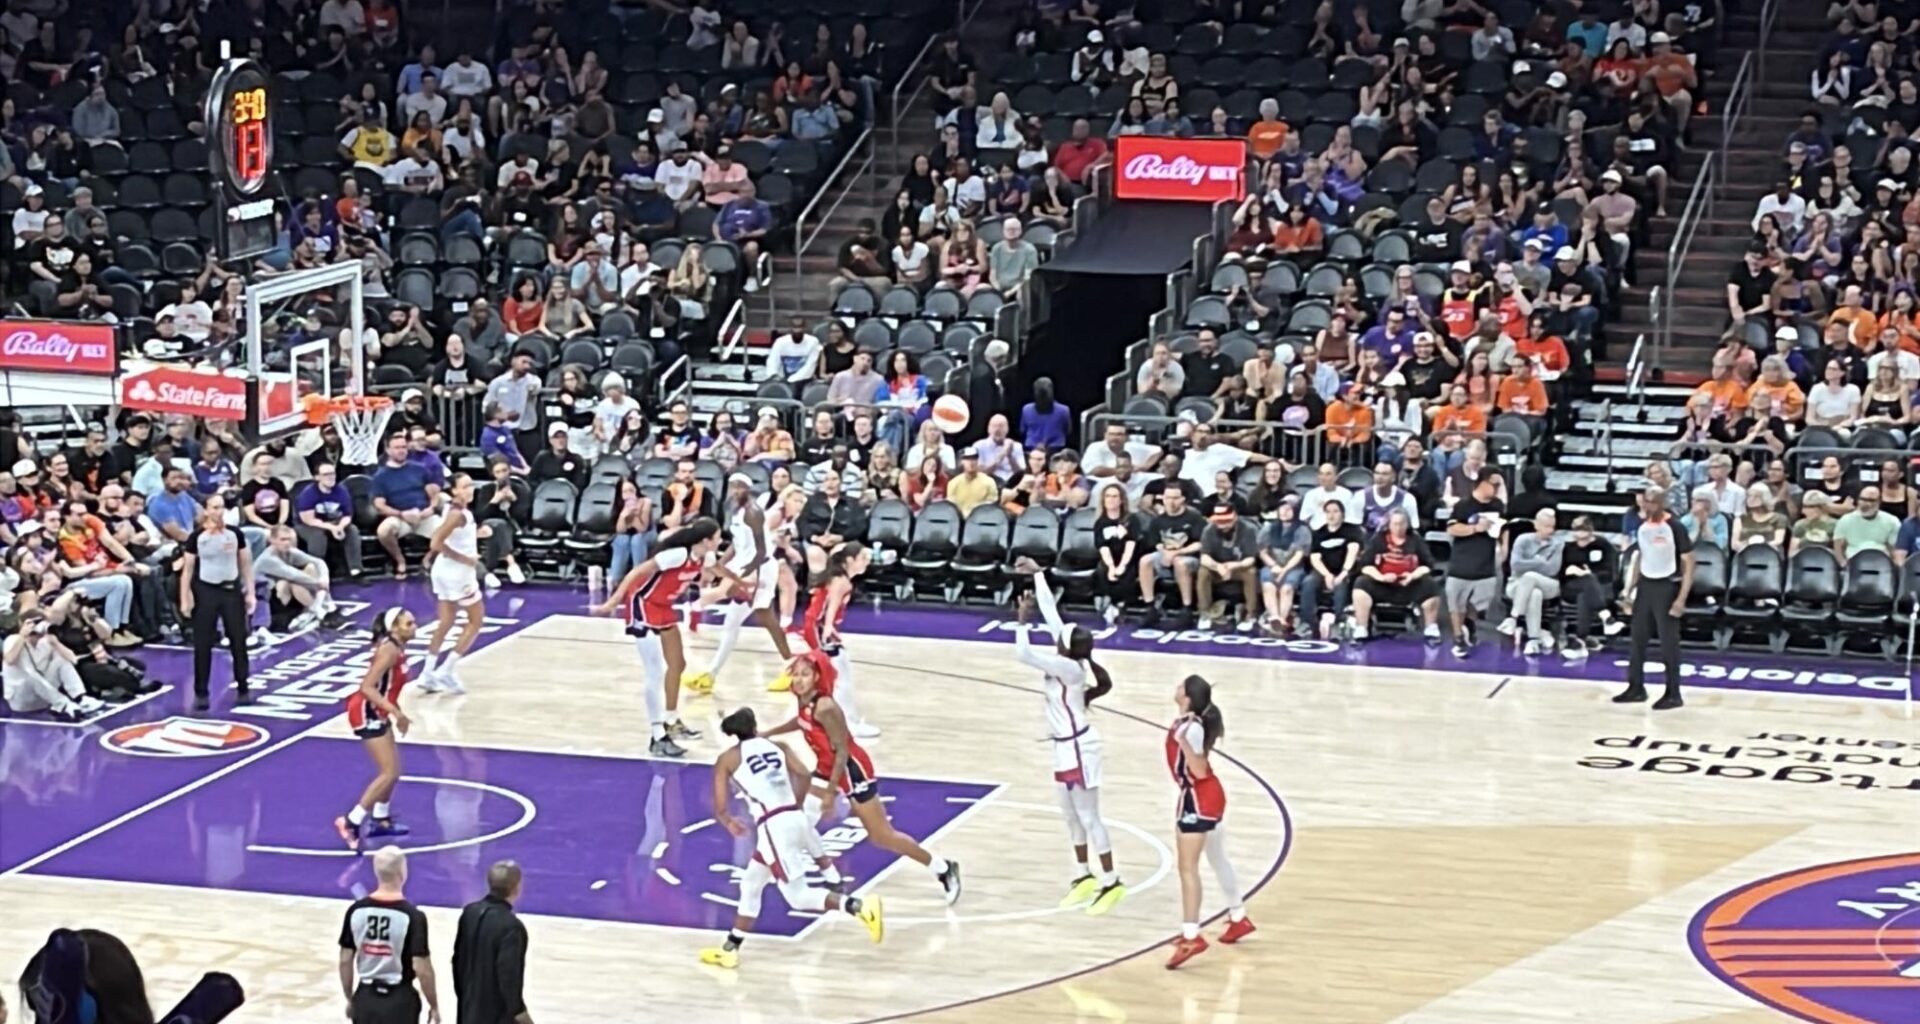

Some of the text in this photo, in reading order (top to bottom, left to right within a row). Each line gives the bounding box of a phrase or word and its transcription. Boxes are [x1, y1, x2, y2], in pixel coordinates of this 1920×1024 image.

[1124, 154, 1207, 186] Bally
[4, 331, 79, 363] Bally
[157, 382, 205, 406] State
[1131, 628, 1340, 653] Google
[746, 751, 782, 775] 25
[366, 914, 391, 941] 32
